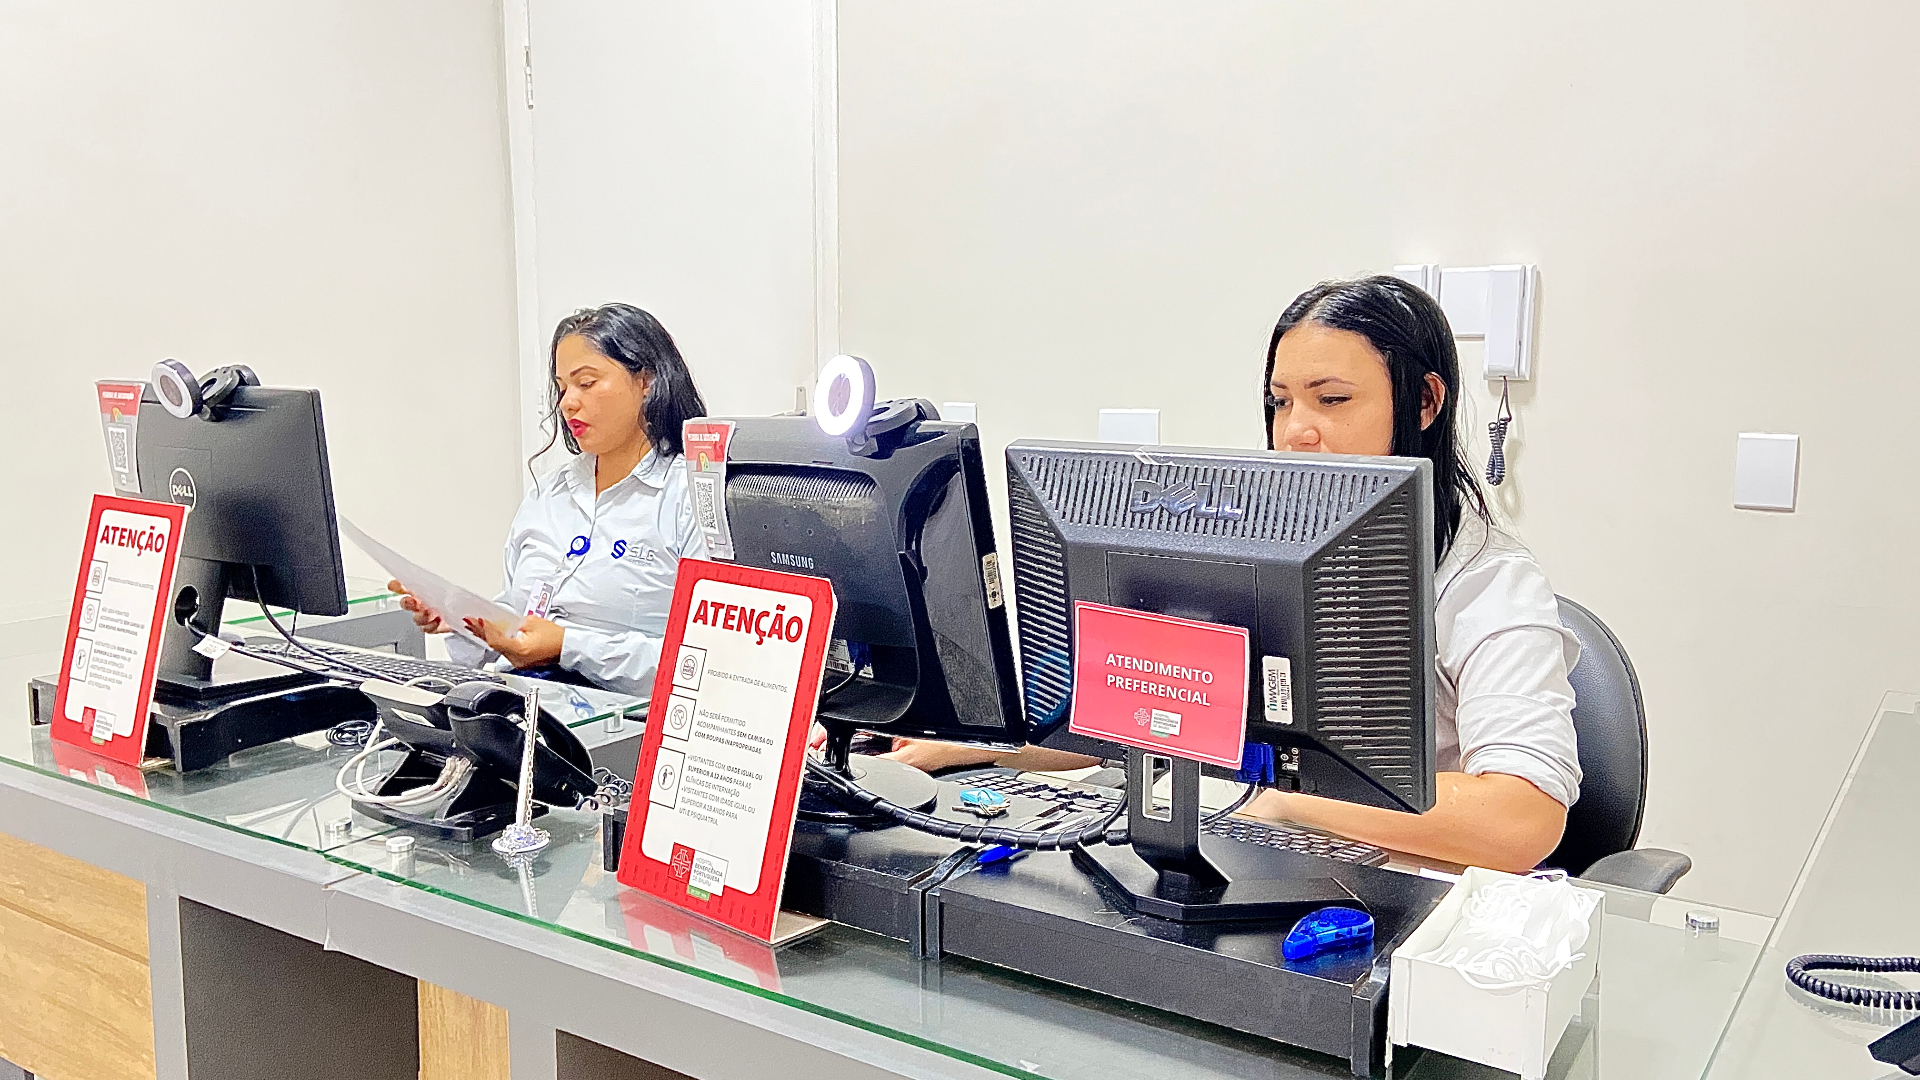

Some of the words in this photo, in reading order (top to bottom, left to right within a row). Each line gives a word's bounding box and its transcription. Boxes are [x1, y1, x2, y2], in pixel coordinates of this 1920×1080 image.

[172, 485, 193, 498] DELL
[1130, 479, 1242, 521] DELL
[100, 524, 165, 557] ATENÇÃO
[770, 551, 814, 570] SAMSUNG
[693, 599, 803, 645] ATENÇÃO
[707, 668, 729, 680] PROIBIDO
[733, 674, 753, 685] ENTRADA
[754, 679, 760, 687] DE
[1106, 653, 1214, 684] ATENDIMENTO
[1106, 674, 1211, 706] PREFERENCIAL
[699, 709, 709, 718] NÃO
[710, 712, 721, 721] SERÁ
[721, 715, 746, 727] PERMITIDO
[694, 730, 706, 738] COM
[706, 733, 725, 744] ROUPAS
[697, 720, 736, 736] ACOMPANHANTES
[736, 730, 747, 738] SEM
[747, 733, 766, 744] CAMISA
[766, 738, 774, 746] OU
[687, 765, 710, 777] SUPERIOR
[732, 778, 745, 787] PARA
[745, 782, 752, 790] AS
[715, 761, 725, 770] COM
[726, 765, 740, 775] IDADE
[740, 769, 754, 779] IGUAL
[755, 773, 763, 781] OU
[704, 781, 712, 789] DE
[711, 782, 740, 798] INTERNAÇÃO
[681, 796, 703, 809] SUPERIOR
[725, 811, 738, 820] PARA
[708, 793, 720, 802] COM
[720, 797, 733, 808] IDADE
[733, 801, 747, 811] IGUAL
[747, 806, 756, 814] OU
